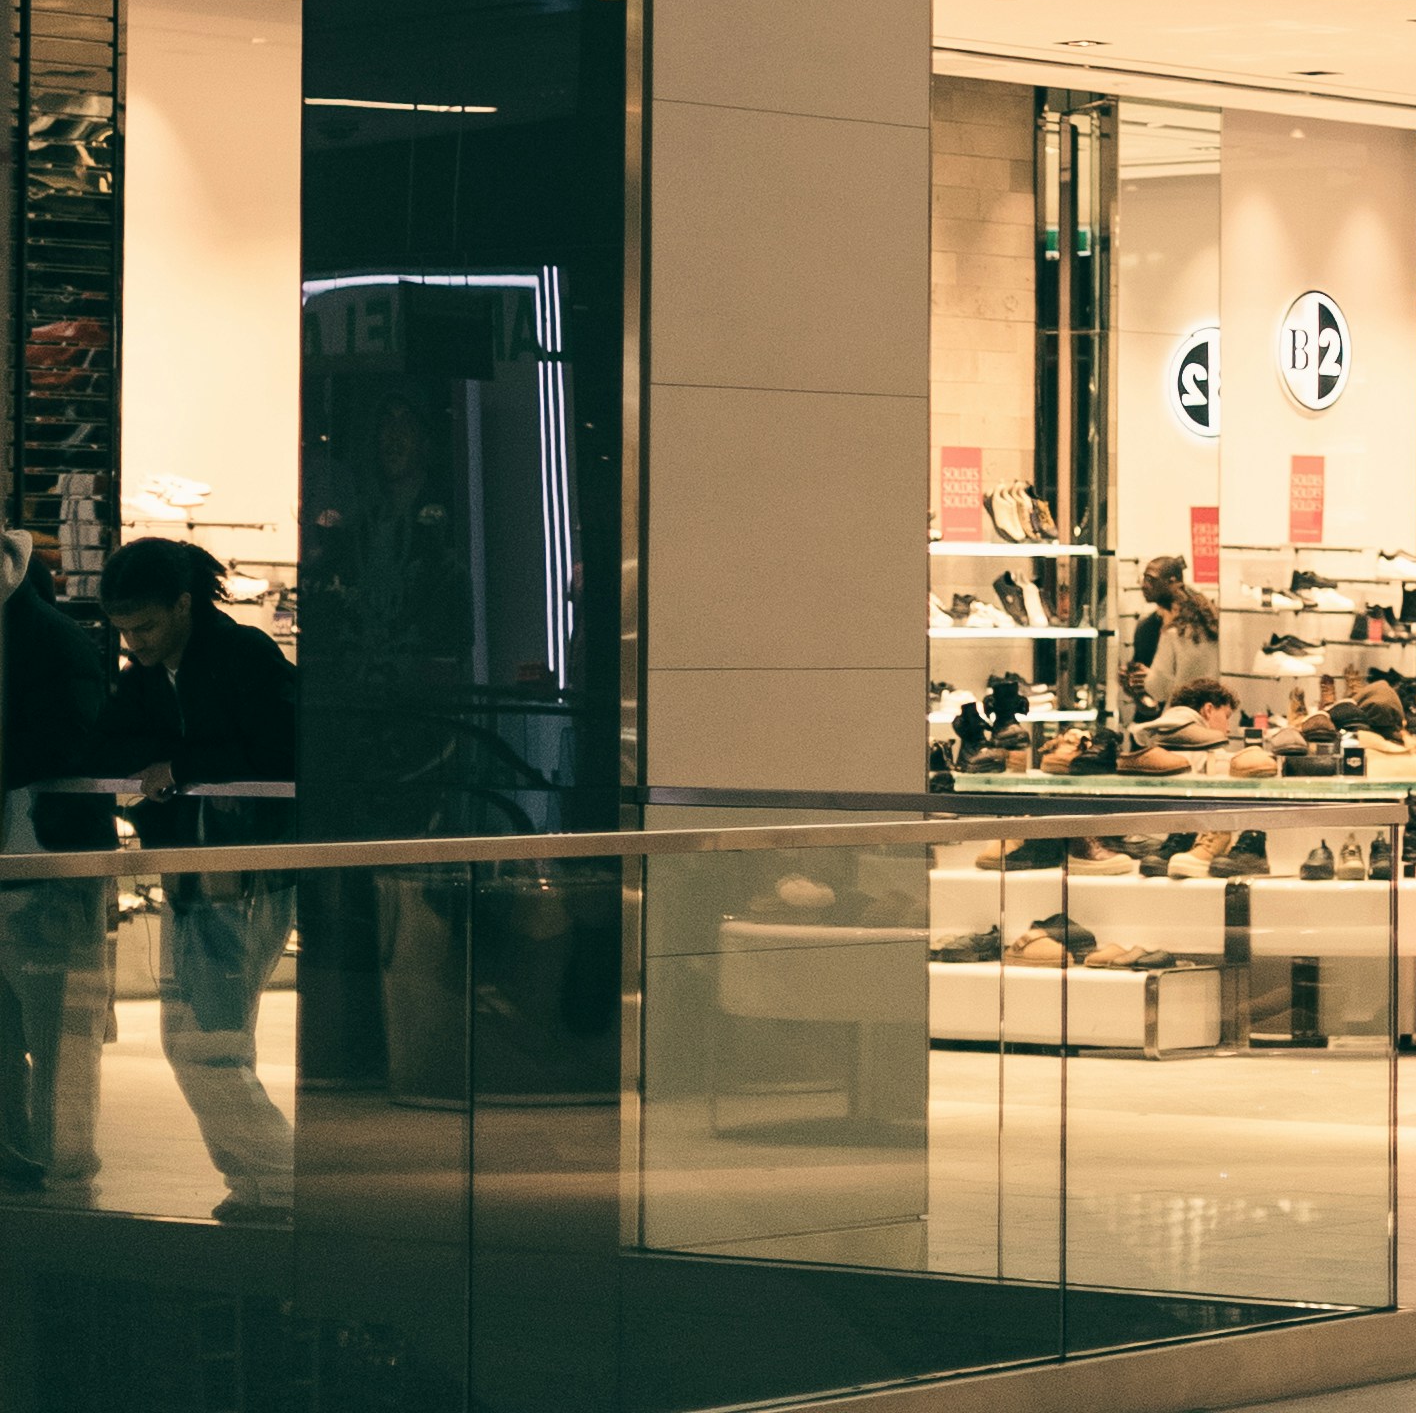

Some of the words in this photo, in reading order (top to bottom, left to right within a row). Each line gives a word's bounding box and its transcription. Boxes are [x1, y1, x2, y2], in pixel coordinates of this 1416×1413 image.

[1289, 327, 1342, 377] B2
[943, 467, 980, 480] SOLDES
[943, 481, 980, 493] SOLDES
[943, 494, 980, 507] SOLDES
